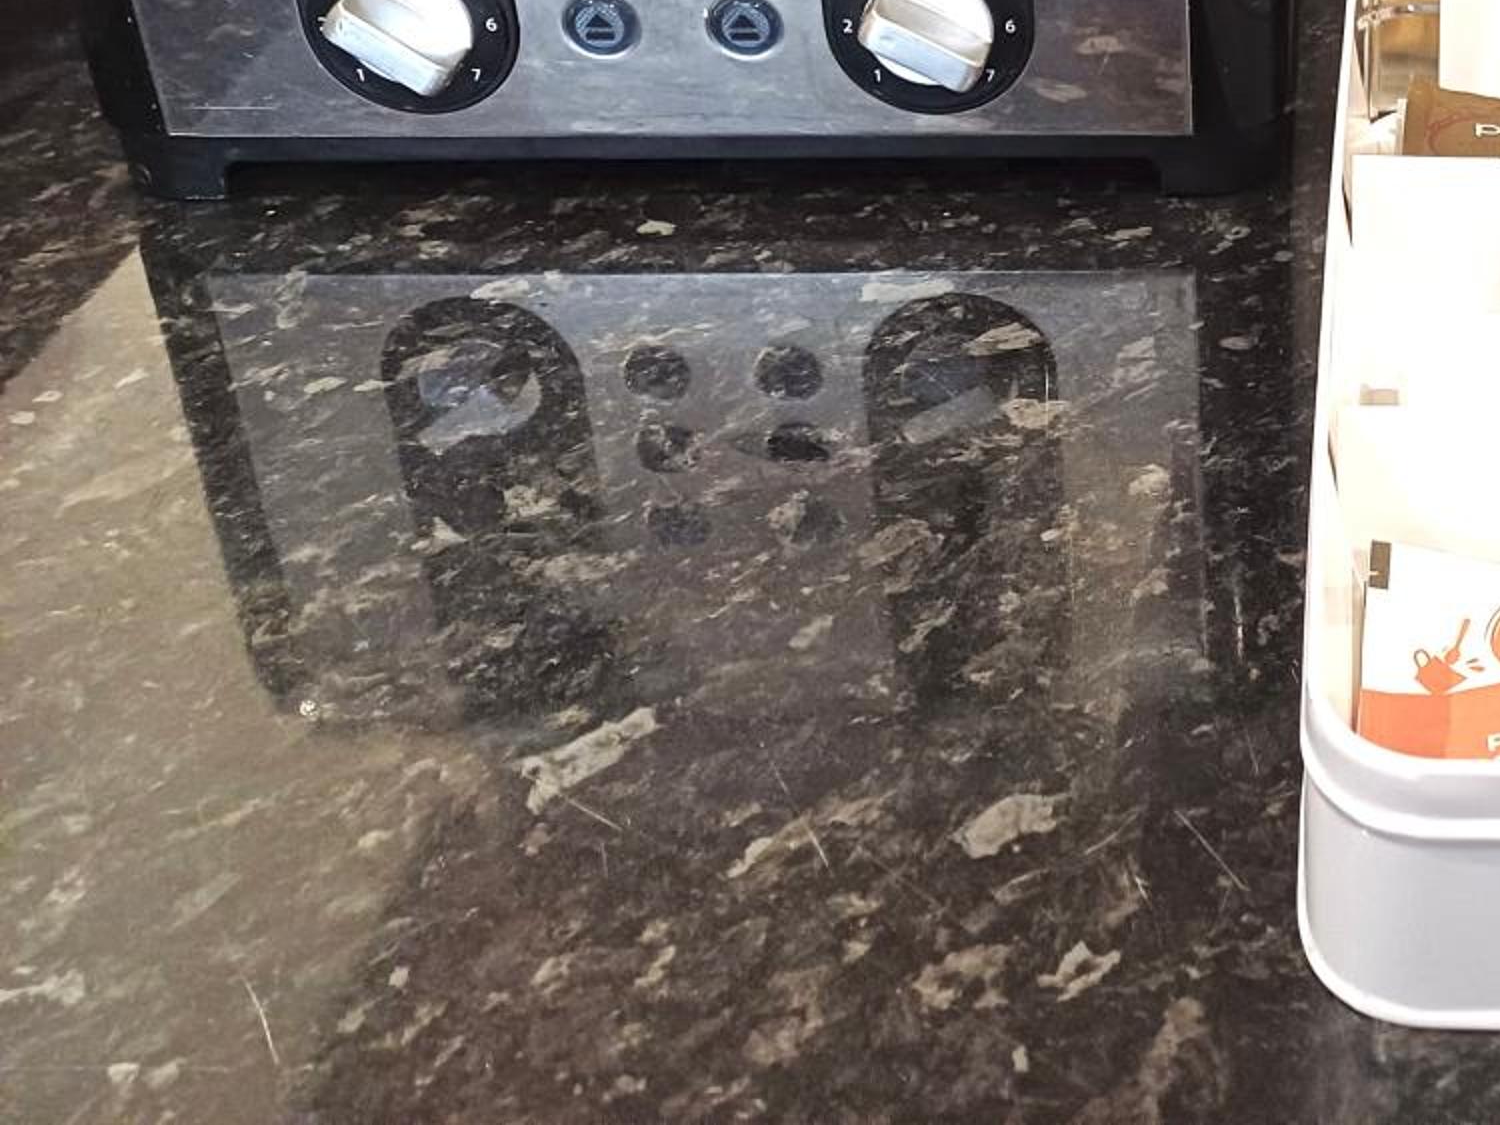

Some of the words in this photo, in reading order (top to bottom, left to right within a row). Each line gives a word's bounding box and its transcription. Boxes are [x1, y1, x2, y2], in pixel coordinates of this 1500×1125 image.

[486, 17, 497, 32] 6
[842, 18, 854, 34] 2
[1005, 20, 1016, 33] 6
